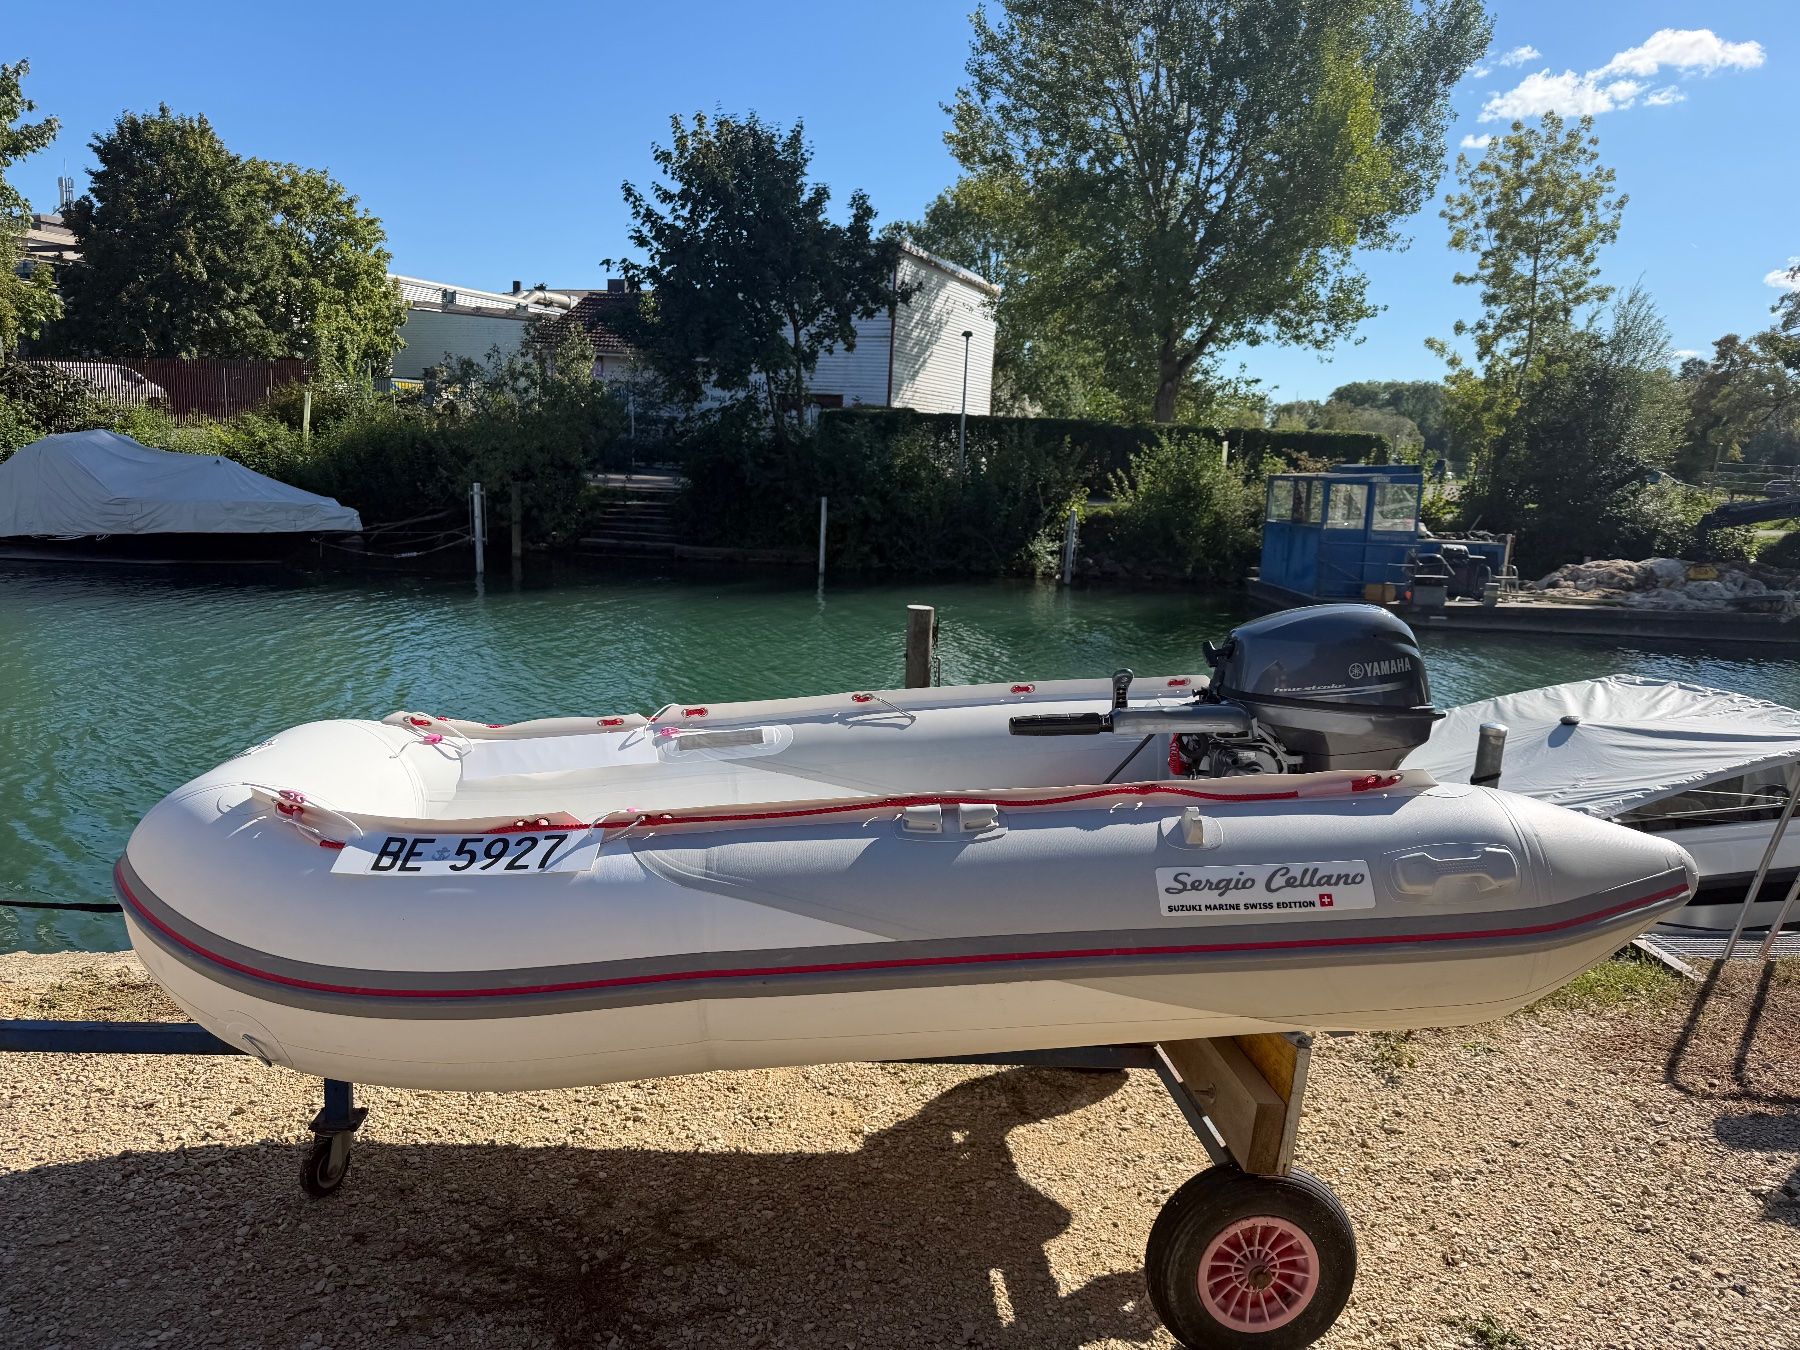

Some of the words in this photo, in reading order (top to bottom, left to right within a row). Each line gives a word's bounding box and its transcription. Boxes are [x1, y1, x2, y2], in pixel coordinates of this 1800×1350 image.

[1364, 657, 1411, 677] YAMAHA
[370, 836, 436, 872] BE
[448, 834, 568, 872] 5927
[1164, 871, 1256, 897] Sergio
[1264, 866, 1365, 893] Cellano
[1167, 904, 1202, 913] SUZUKI
[1204, 903, 1241, 912] MARINE
[1243, 902, 1274, 910] SWISS
[1276, 900, 1316, 909] EDITION
